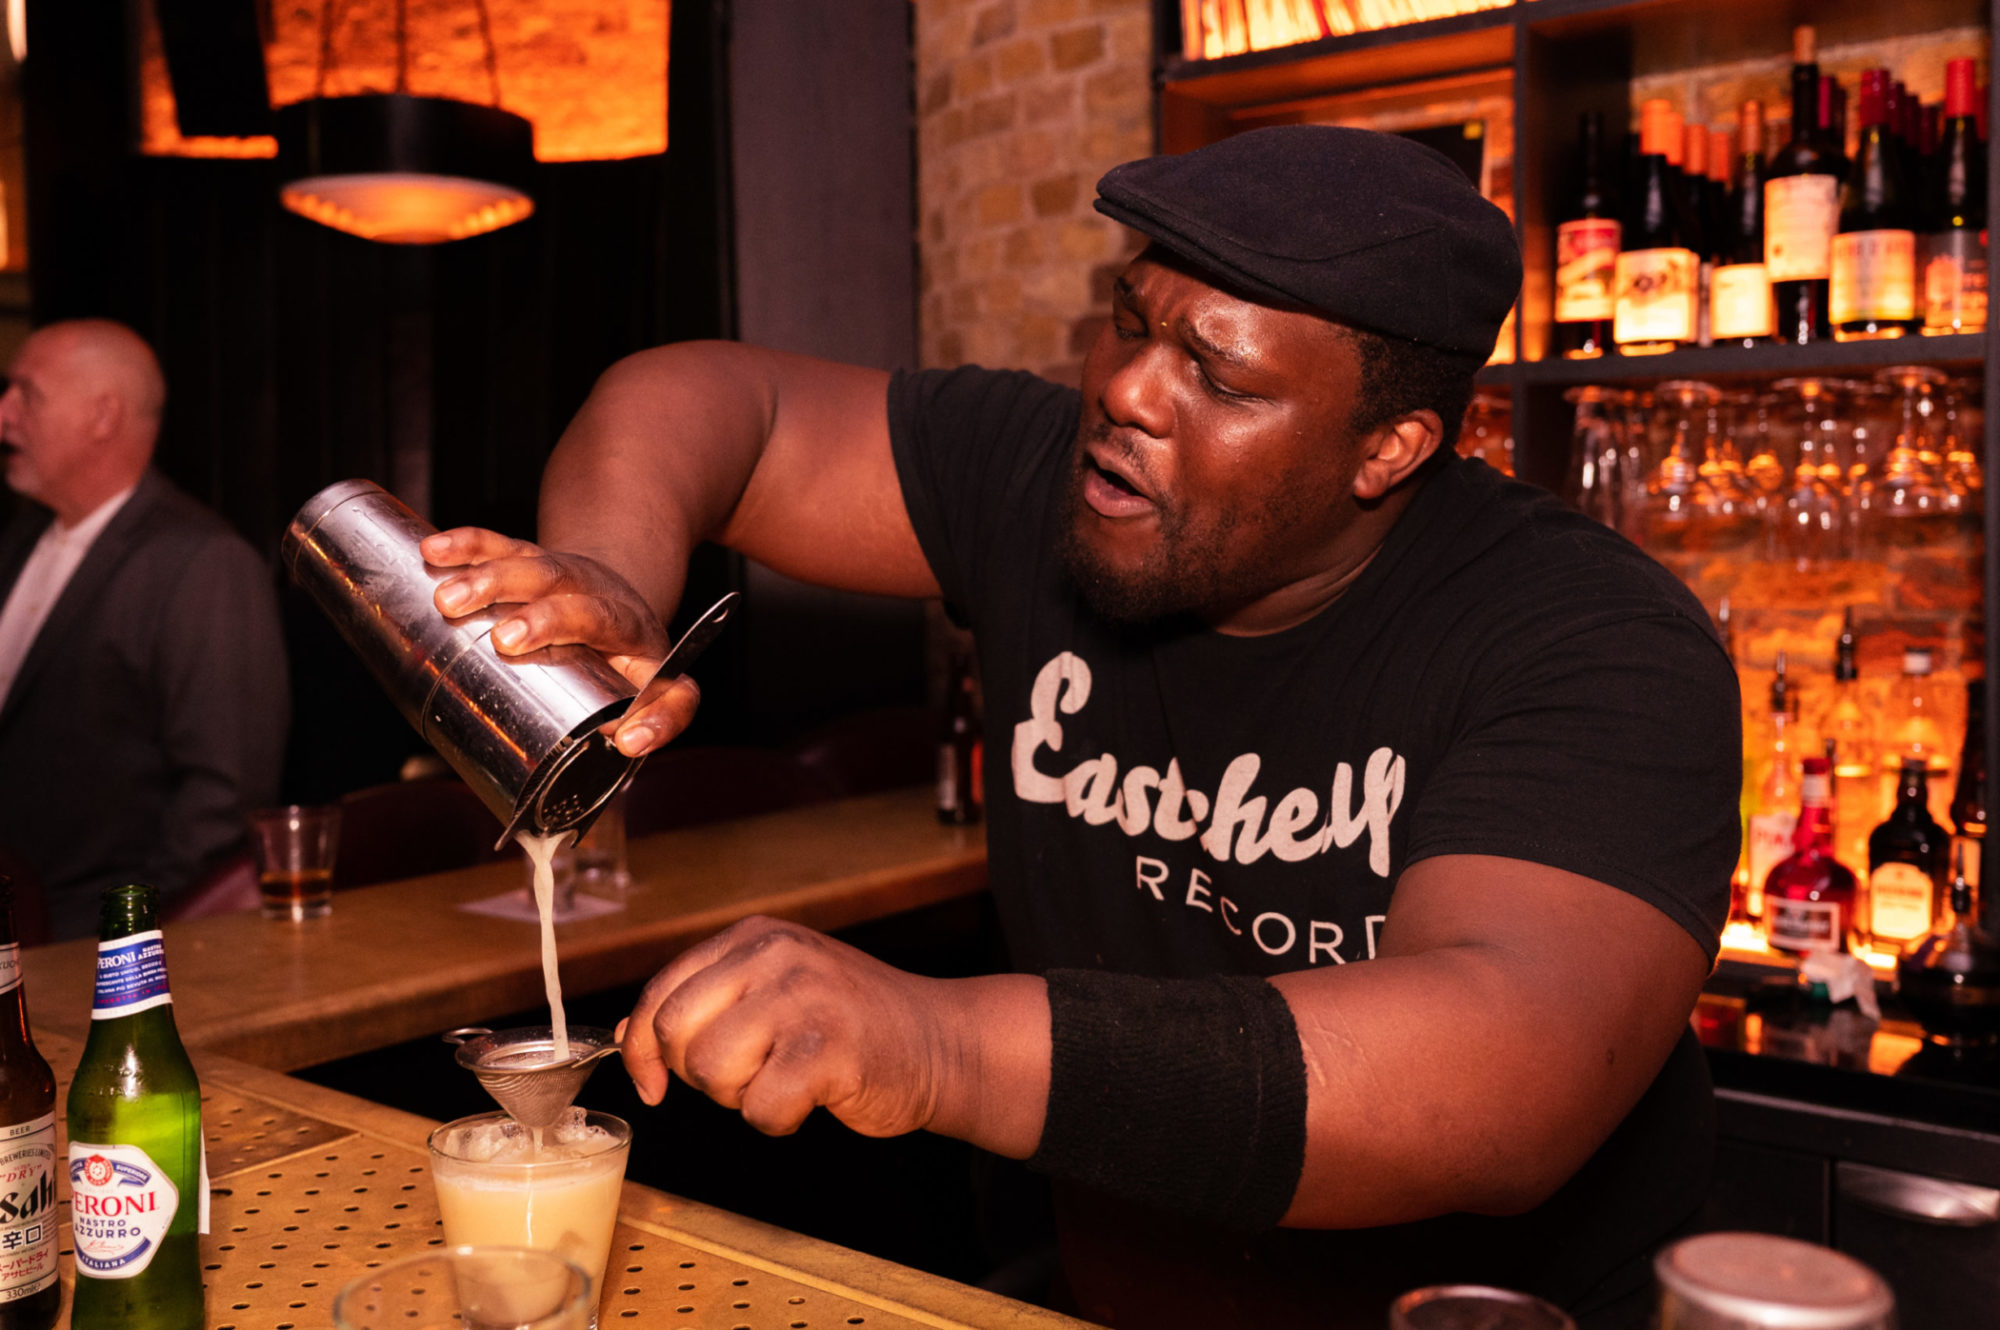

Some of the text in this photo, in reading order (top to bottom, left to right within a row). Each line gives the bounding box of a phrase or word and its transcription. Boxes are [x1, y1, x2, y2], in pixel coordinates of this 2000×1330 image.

[9, 1126, 31, 1136] BEER
[79, 1216, 127, 1228] NASTRO
[2, 1225, 41, 1250] 辛口
[81, 1255, 126, 1269] ITALIANA
